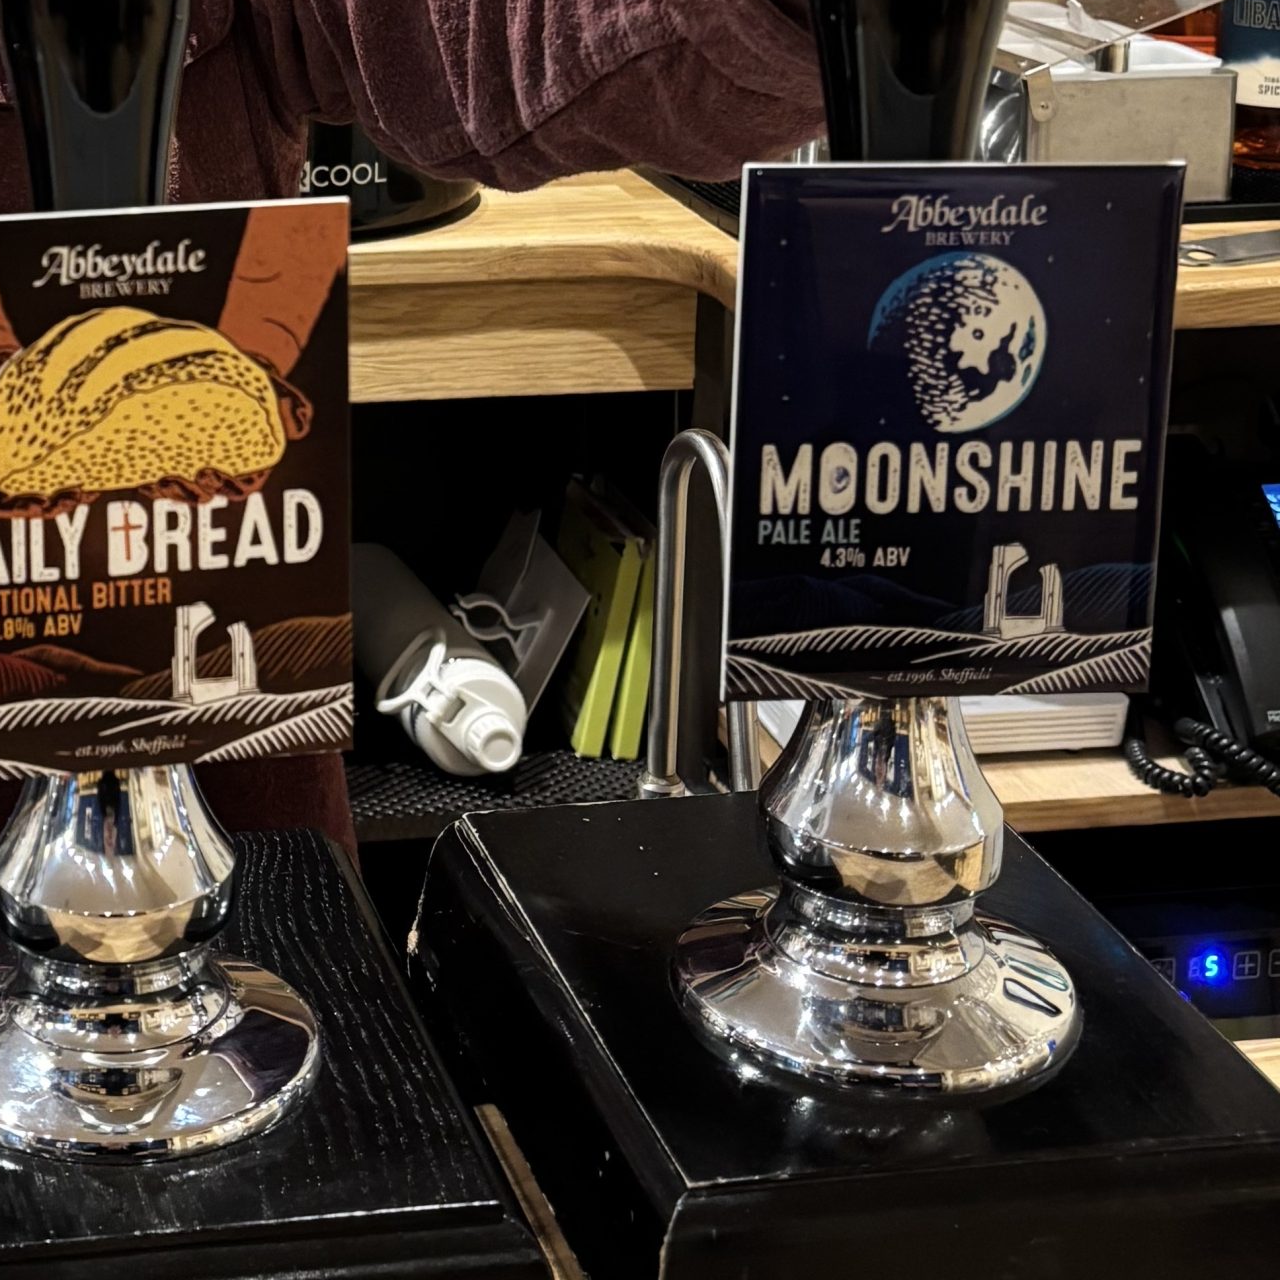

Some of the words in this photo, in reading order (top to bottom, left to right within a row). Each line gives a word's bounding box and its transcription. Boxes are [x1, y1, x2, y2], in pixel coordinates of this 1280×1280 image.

[881, 195, 1048, 232] Abbeydale
[925, 231, 1014, 246] BREWERY
[32, 238, 207, 288] Abbeydale
[79, 278, 174, 300] BREWERY
[760, 440, 1143, 516] MOONSHINE
[107, 489, 323, 577] BREAD
[758, 519, 811, 545] PALE
[821, 519, 861, 544] ALE
[820, 548, 866, 567] 4.3%
[873, 547, 910, 567] ABV
[92, 577, 172, 609] BITTER
[44, 613, 82, 636] ABV
[939, 667, 993, 682] Sheffield
[130, 734, 186, 754] Sheffield
